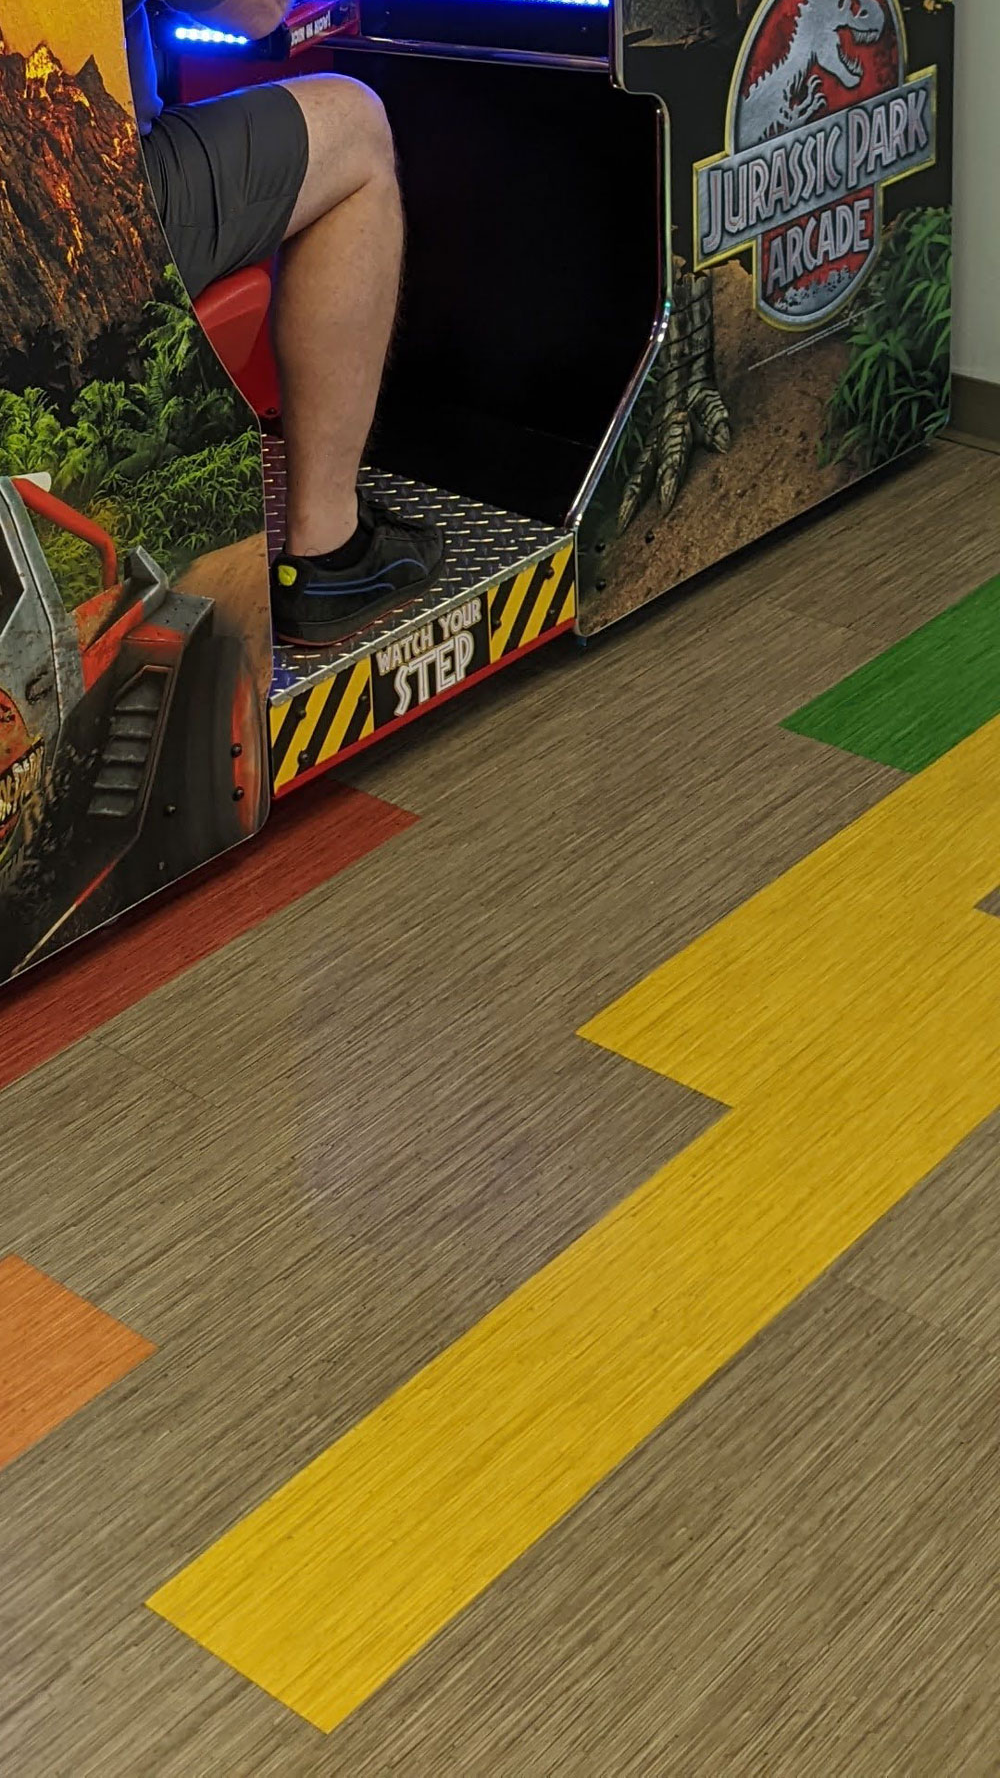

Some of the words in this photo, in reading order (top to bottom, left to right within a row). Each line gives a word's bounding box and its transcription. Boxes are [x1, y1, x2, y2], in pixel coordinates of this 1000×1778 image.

[703, 125, 843, 251] JURASSIC
[847, 90, 929, 189] PARK
[767, 198, 872, 295] ARCADE
[376, 622, 434, 676] WATCH
[438, 597, 482, 640] YOUR
[394, 630, 475, 716] STEP
